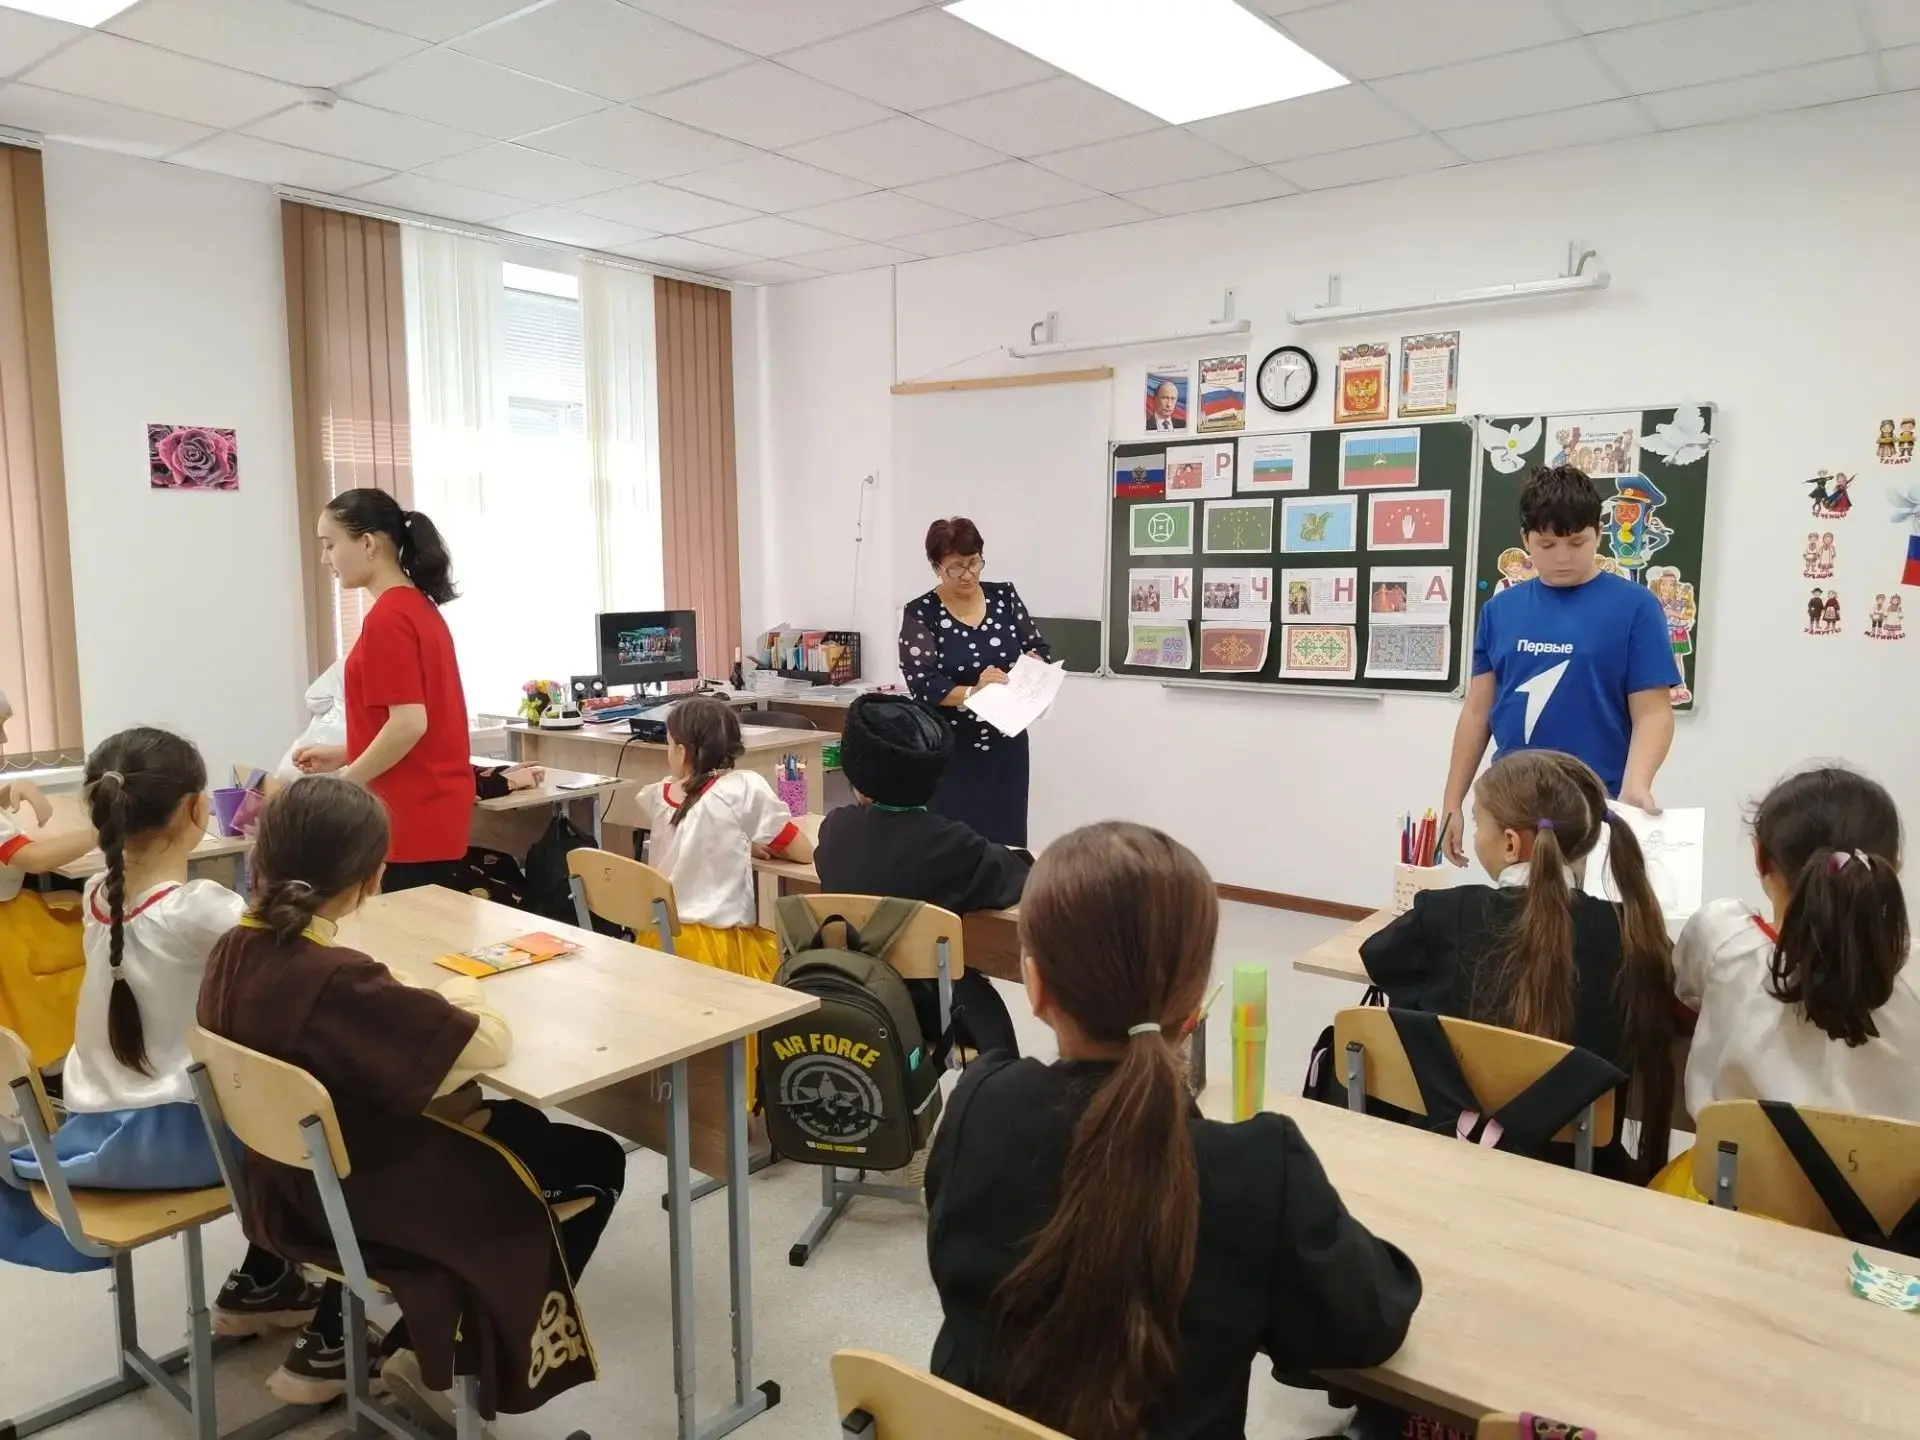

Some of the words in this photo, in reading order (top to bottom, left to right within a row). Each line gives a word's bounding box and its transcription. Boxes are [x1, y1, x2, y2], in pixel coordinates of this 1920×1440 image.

[1216, 452, 1231, 477] Р
[1173, 576, 1189, 599] К
[1251, 576, 1268, 600] Ч
[1334, 577, 1354, 602] Н
[1424, 575, 1448, 601] А
[1517, 639, 1574, 656] Первые
[772, 1033, 808, 1061] AIR
[809, 1033, 881, 1069] FORCE
[1847, 1149, 1859, 1172] 5
